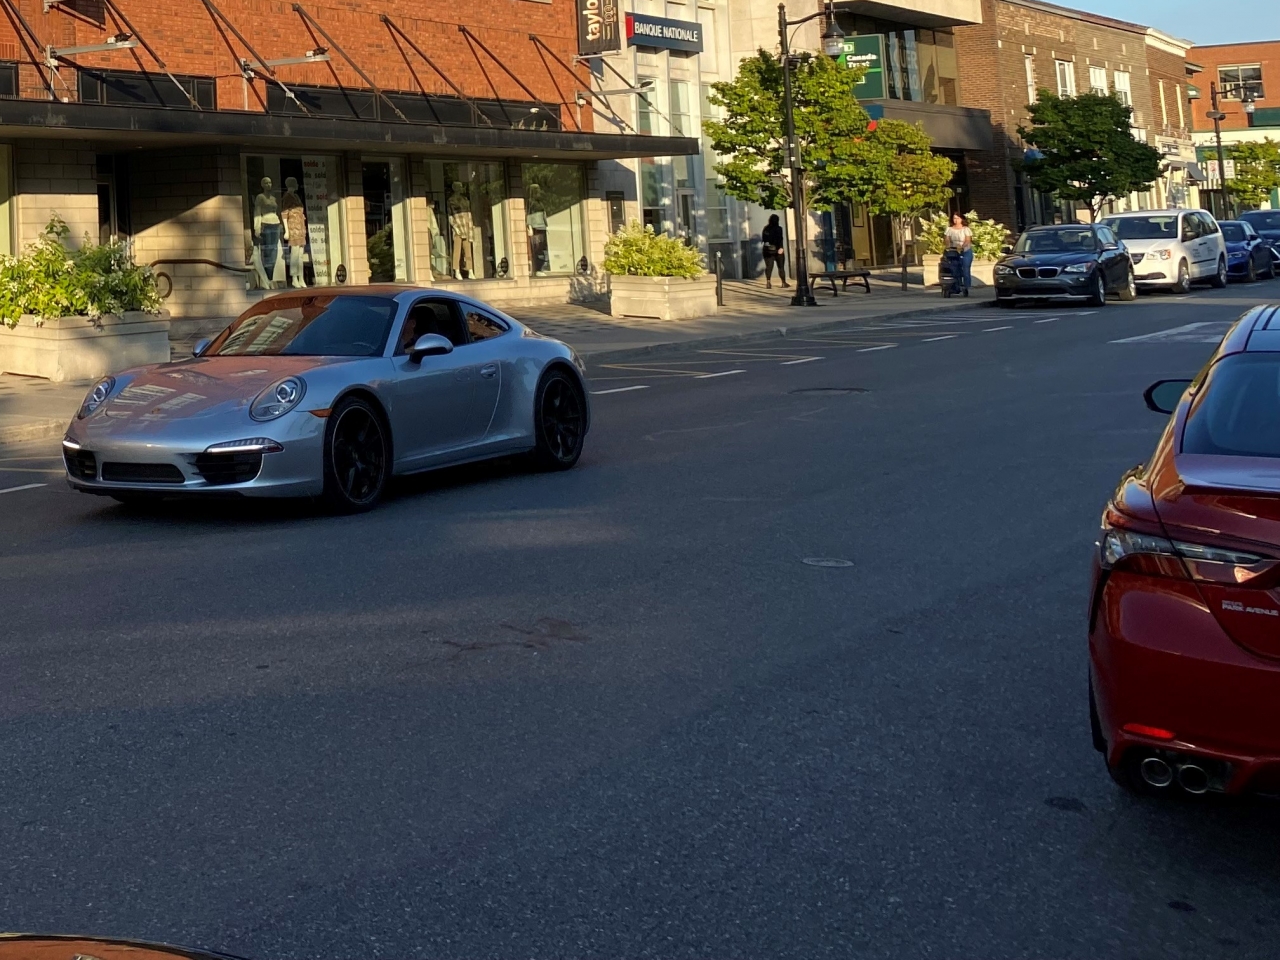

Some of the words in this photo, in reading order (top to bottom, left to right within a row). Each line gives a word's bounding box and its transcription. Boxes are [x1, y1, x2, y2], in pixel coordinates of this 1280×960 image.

[634, 22, 663, 37] BANQUE
[663, 26, 699, 42] NATIONALE
[846, 53, 877, 61] Canada
